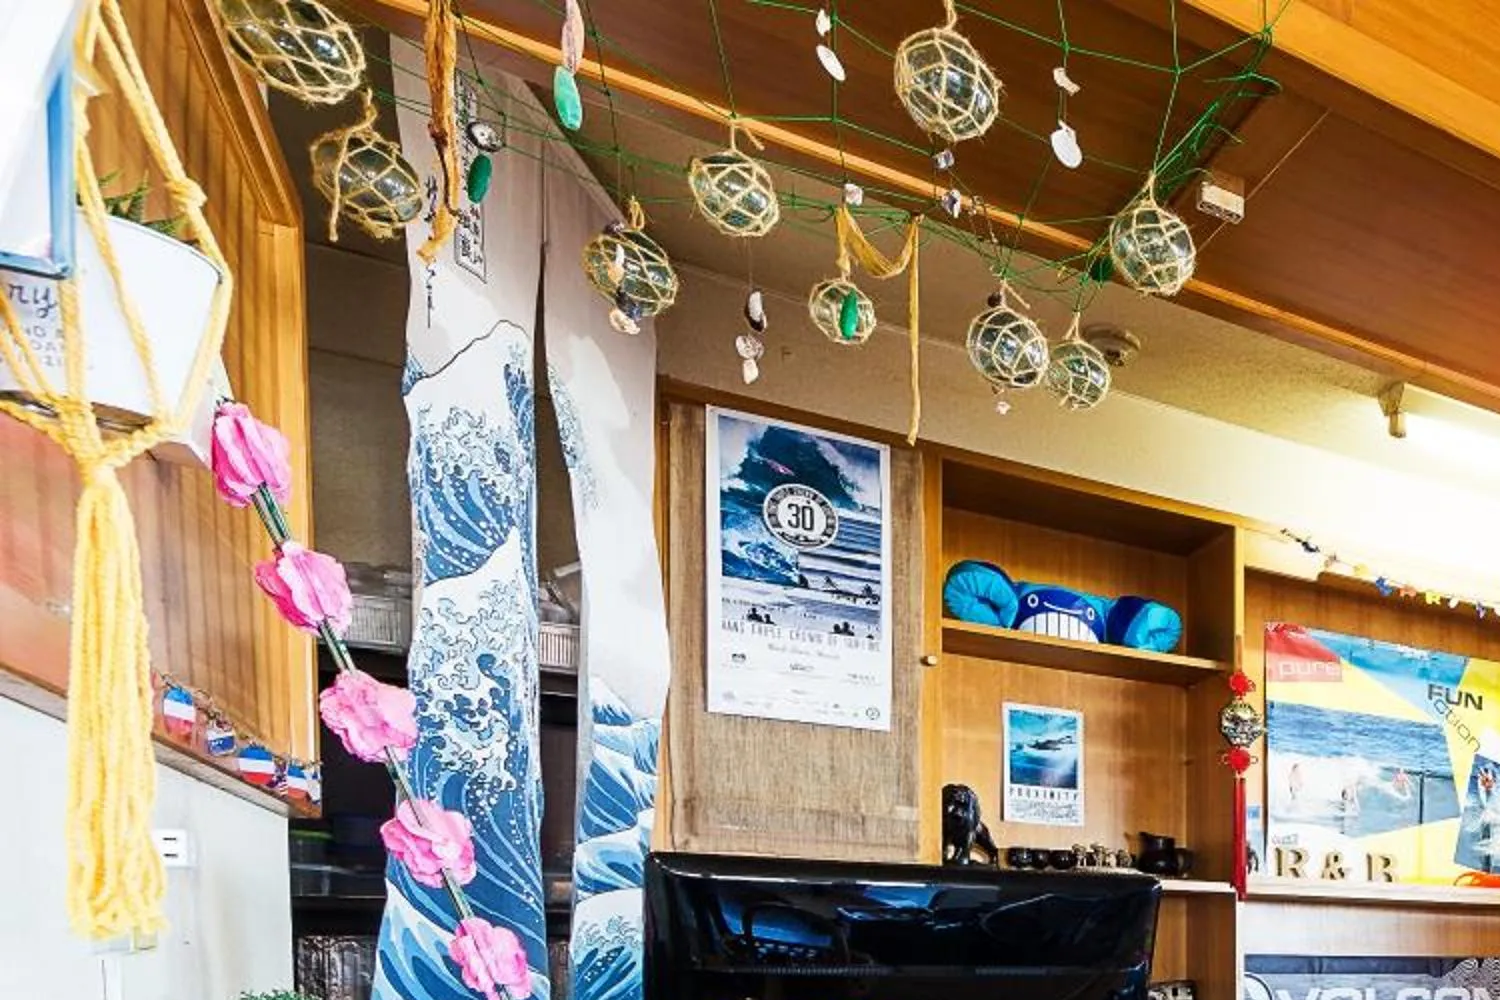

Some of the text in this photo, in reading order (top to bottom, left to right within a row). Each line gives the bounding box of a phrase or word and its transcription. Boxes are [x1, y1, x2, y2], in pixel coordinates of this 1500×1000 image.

[787, 502, 814, 531] 30
[1427, 683, 1484, 712] FUN
[1274, 846, 1400, 883] R & R
